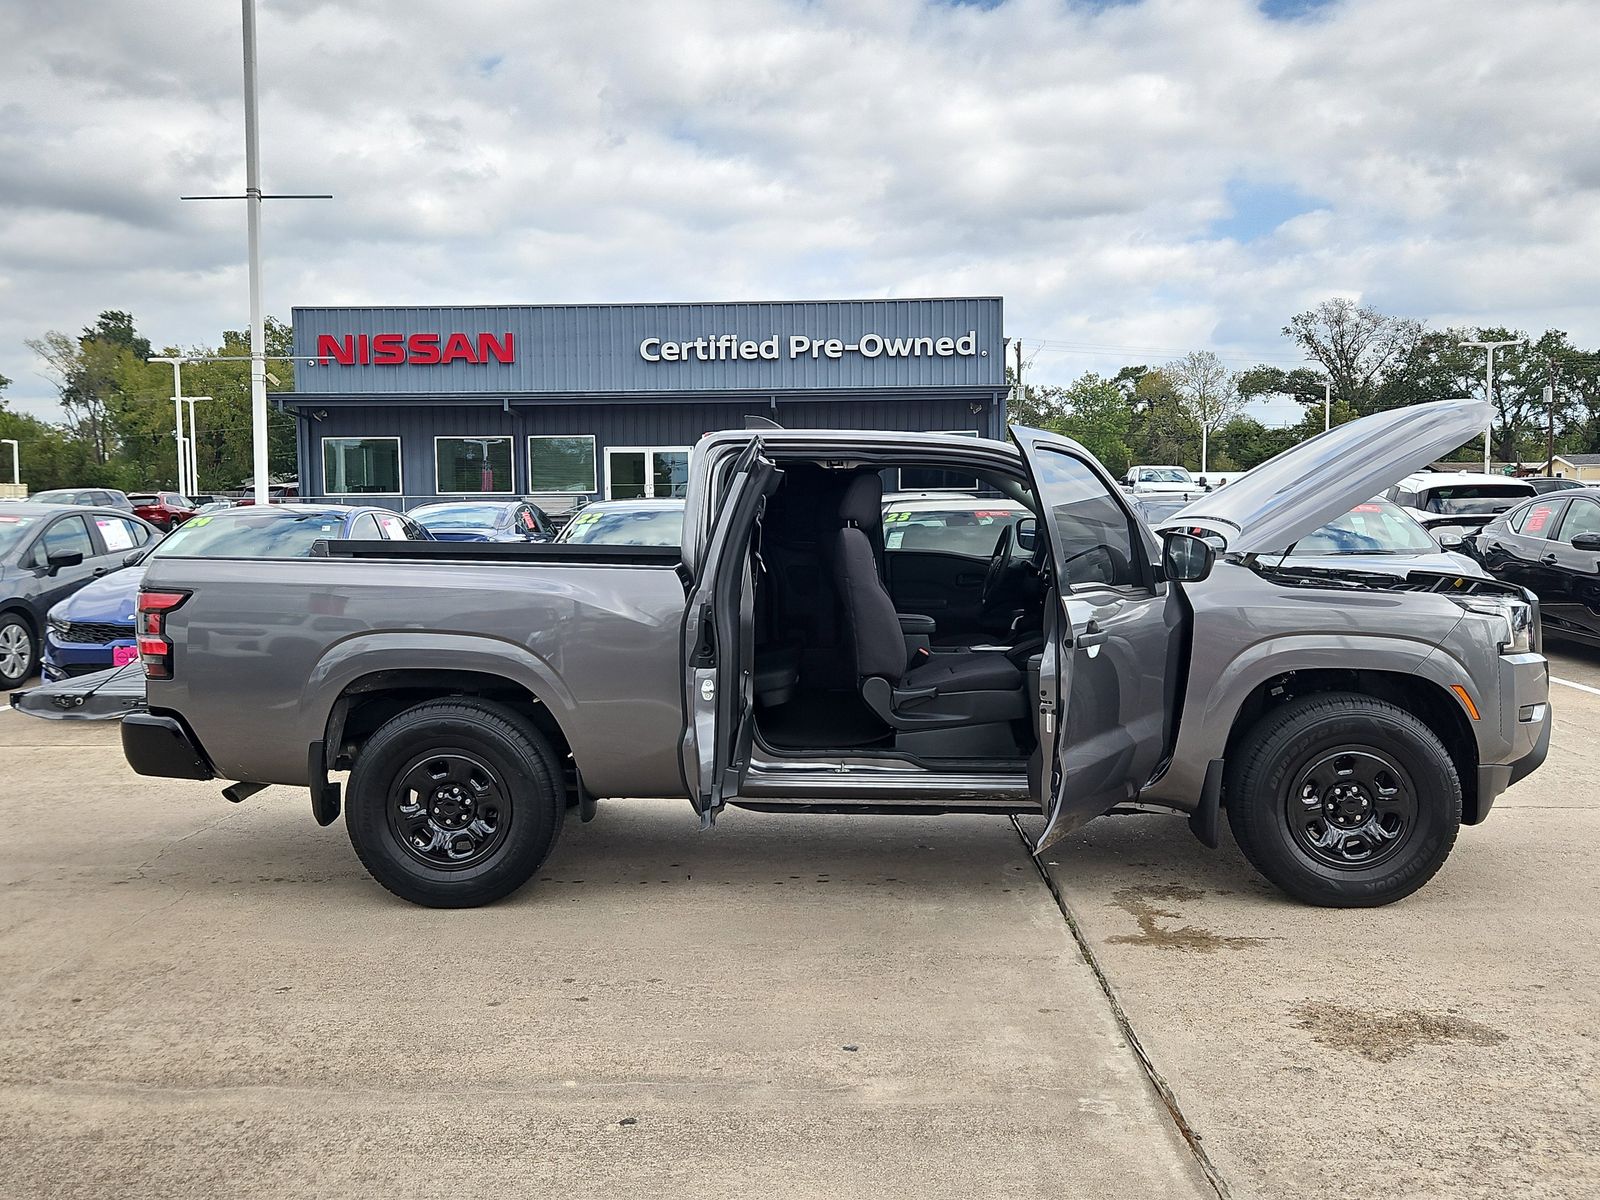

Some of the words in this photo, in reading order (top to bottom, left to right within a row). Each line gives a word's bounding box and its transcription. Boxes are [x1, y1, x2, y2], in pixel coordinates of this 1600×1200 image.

[318, 333, 514, 365] NISSAN
[640, 335, 780, 361] Certified
[884, 512, 911, 522] 23
